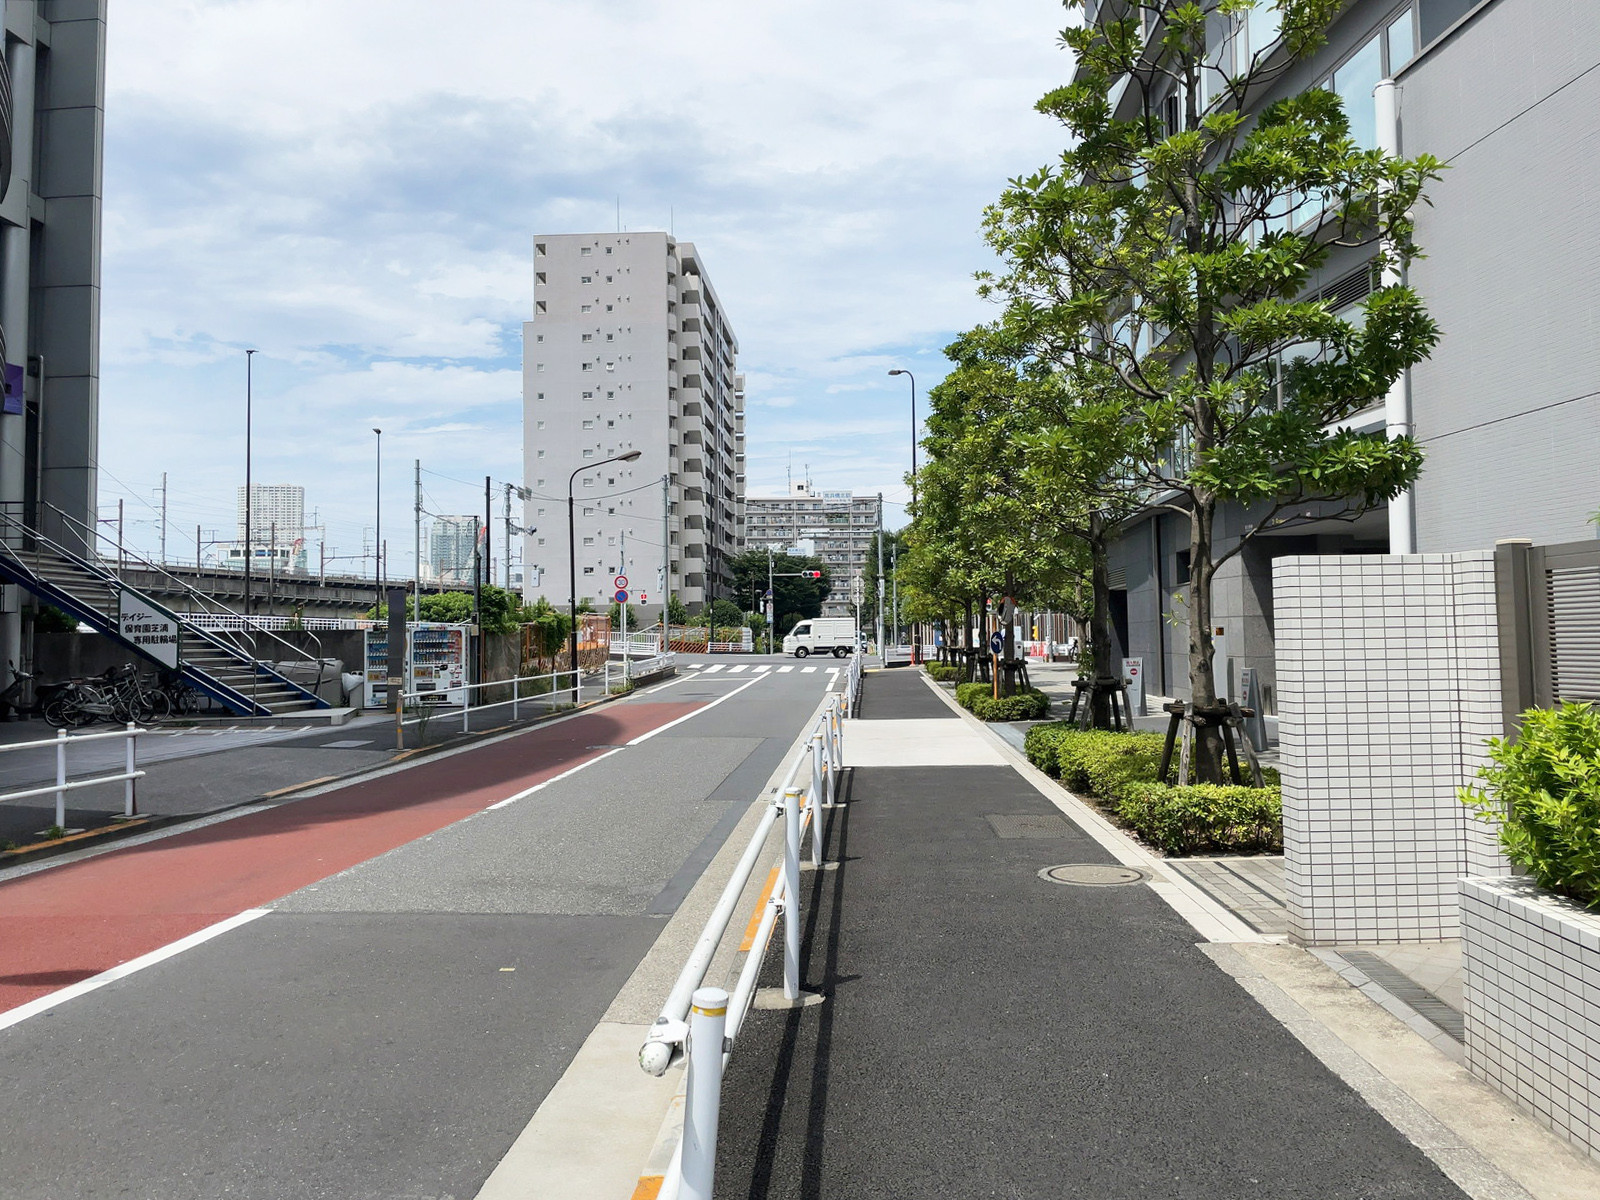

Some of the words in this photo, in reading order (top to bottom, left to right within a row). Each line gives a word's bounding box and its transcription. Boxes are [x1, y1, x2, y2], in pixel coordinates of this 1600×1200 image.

[125, 624, 168, 633] 保育園芝浦
[133, 635, 177, 644] 専用駐輪場
